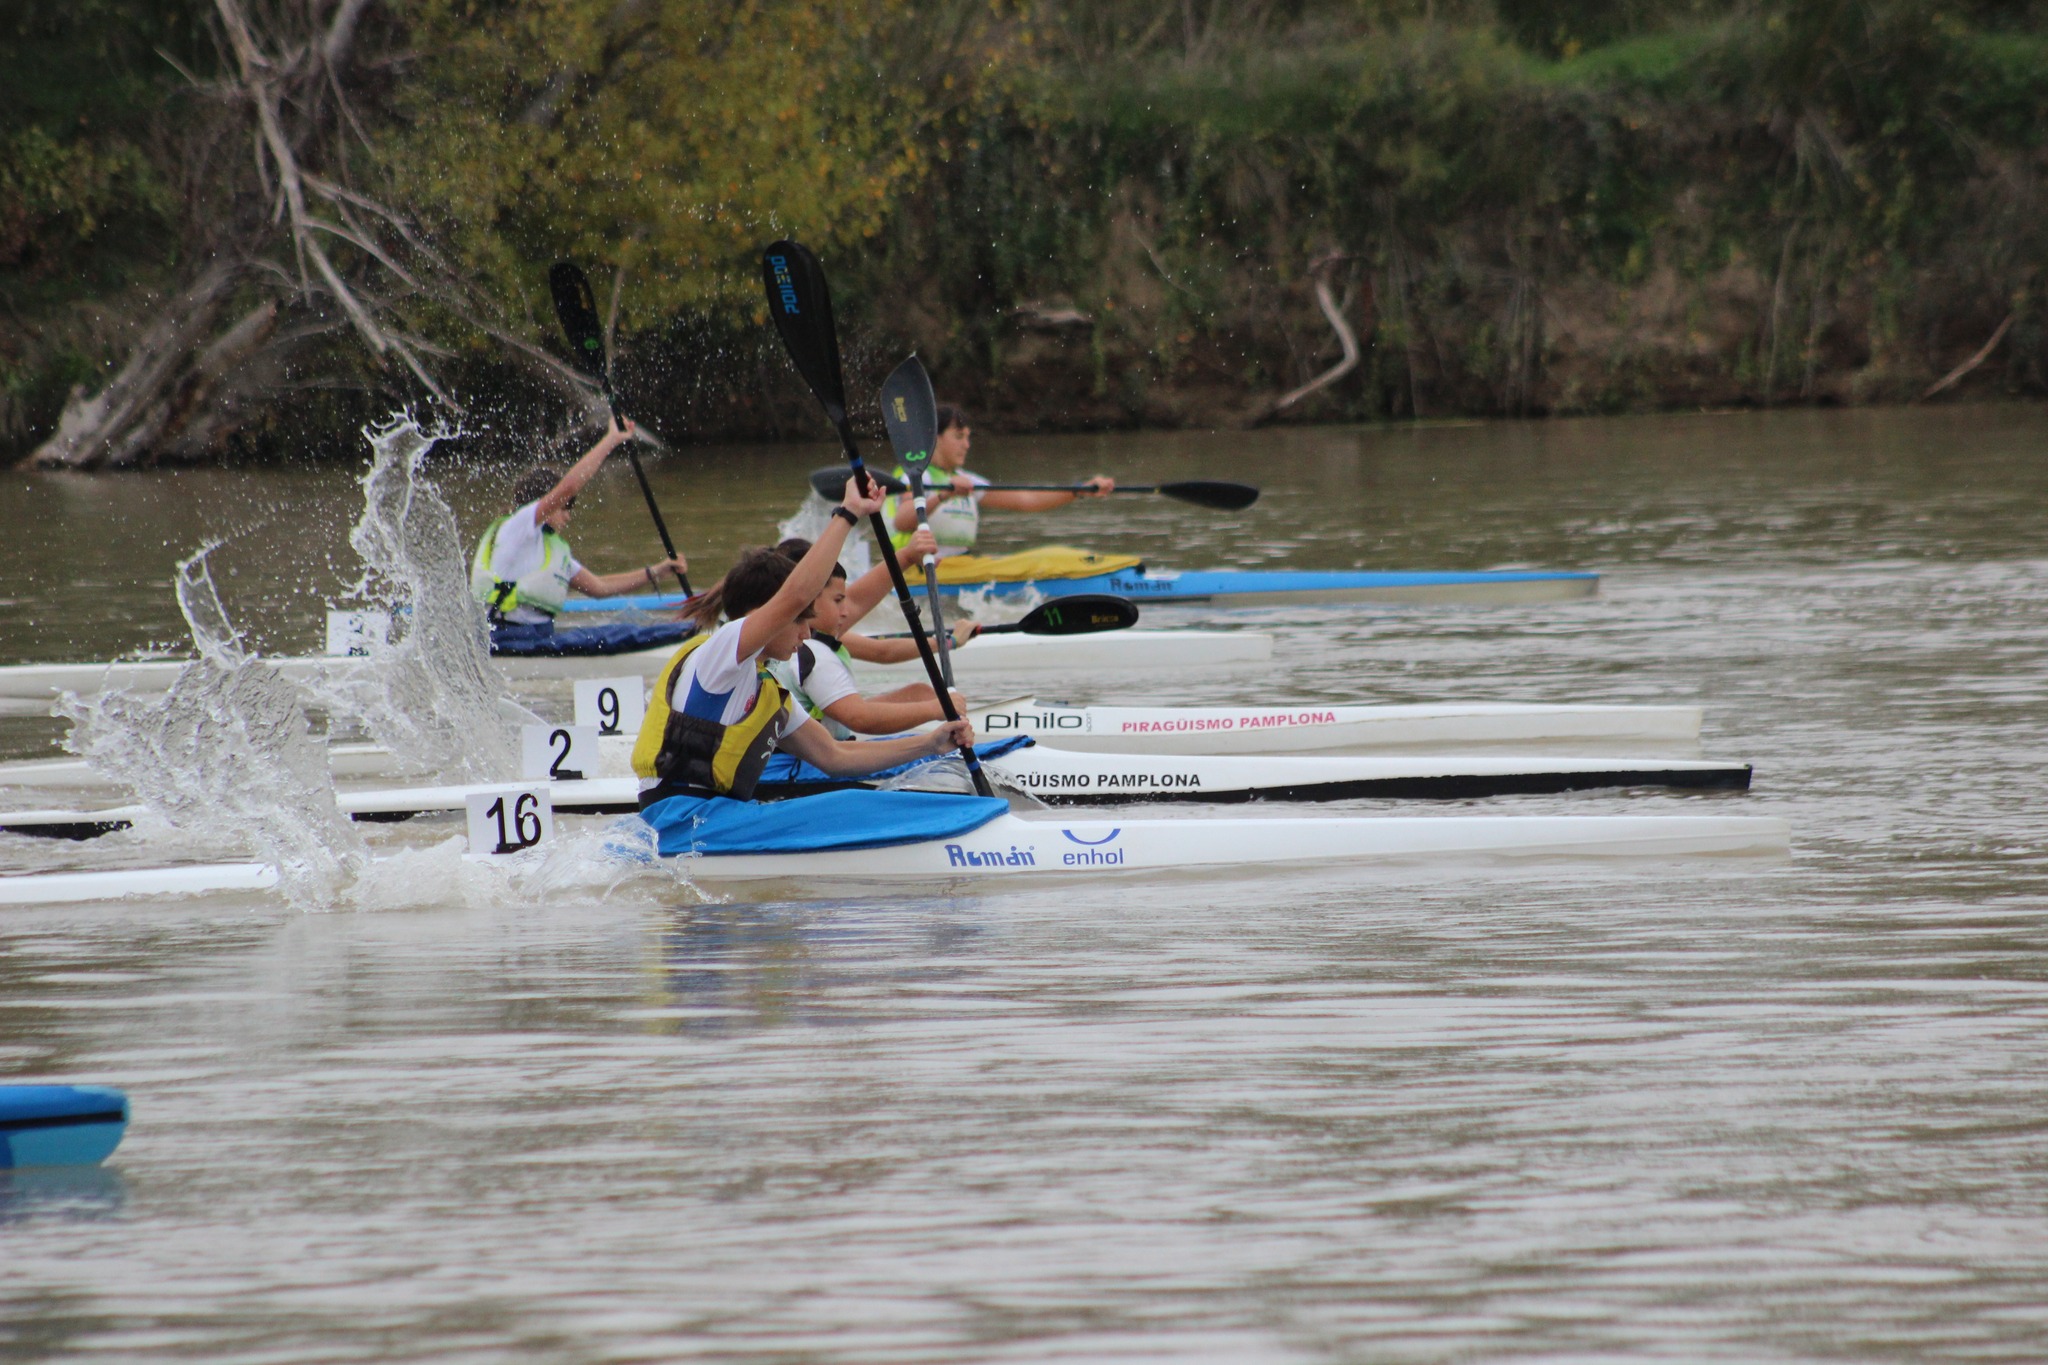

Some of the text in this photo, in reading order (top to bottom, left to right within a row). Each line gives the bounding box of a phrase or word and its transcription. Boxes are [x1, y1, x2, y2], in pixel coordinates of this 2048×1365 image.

[1043, 607, 1063, 626] 11
[598, 687, 619, 731] 9
[985, 712, 1082, 732] philo
[1122, 712, 1336, 732] PIRAGÜISMO PAMPLONA
[549, 729, 571, 777] 2
[1097, 774, 1201, 787] PAMPLONA
[486, 793, 542, 848] 16
[1063, 848, 1124, 865] enhol
